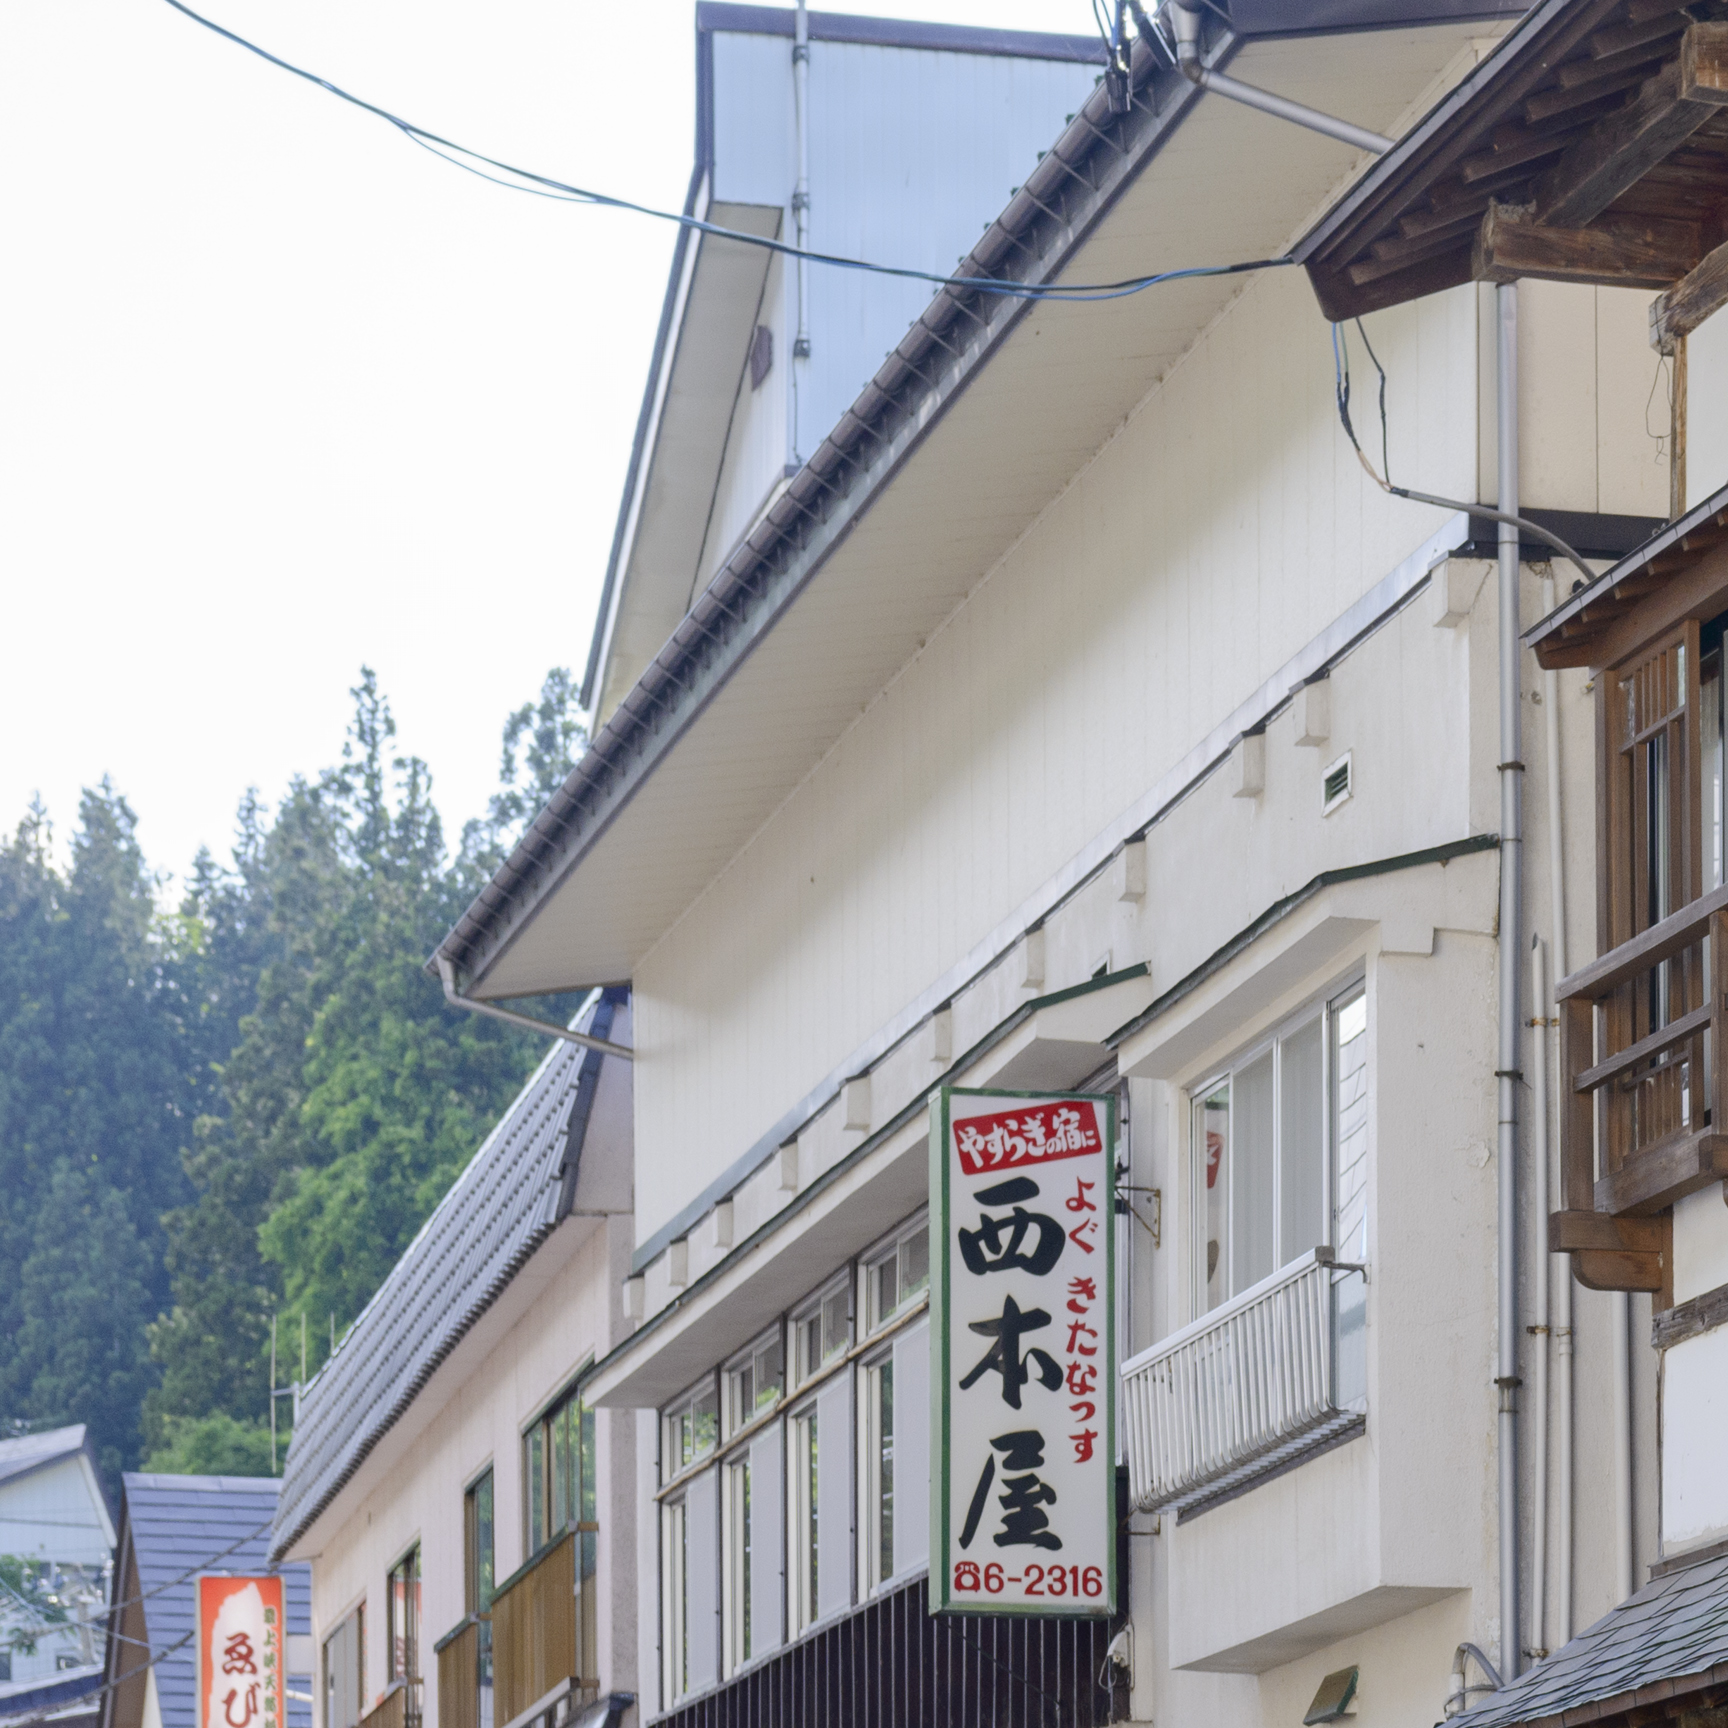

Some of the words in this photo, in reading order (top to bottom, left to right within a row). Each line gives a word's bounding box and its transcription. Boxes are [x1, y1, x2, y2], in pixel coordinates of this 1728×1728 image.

[958, 1107, 1097, 1169] やすらぎの宿に
[1064, 1275, 1099, 1464] きたなっす
[983, 1562, 1104, 1598] 6-2316
